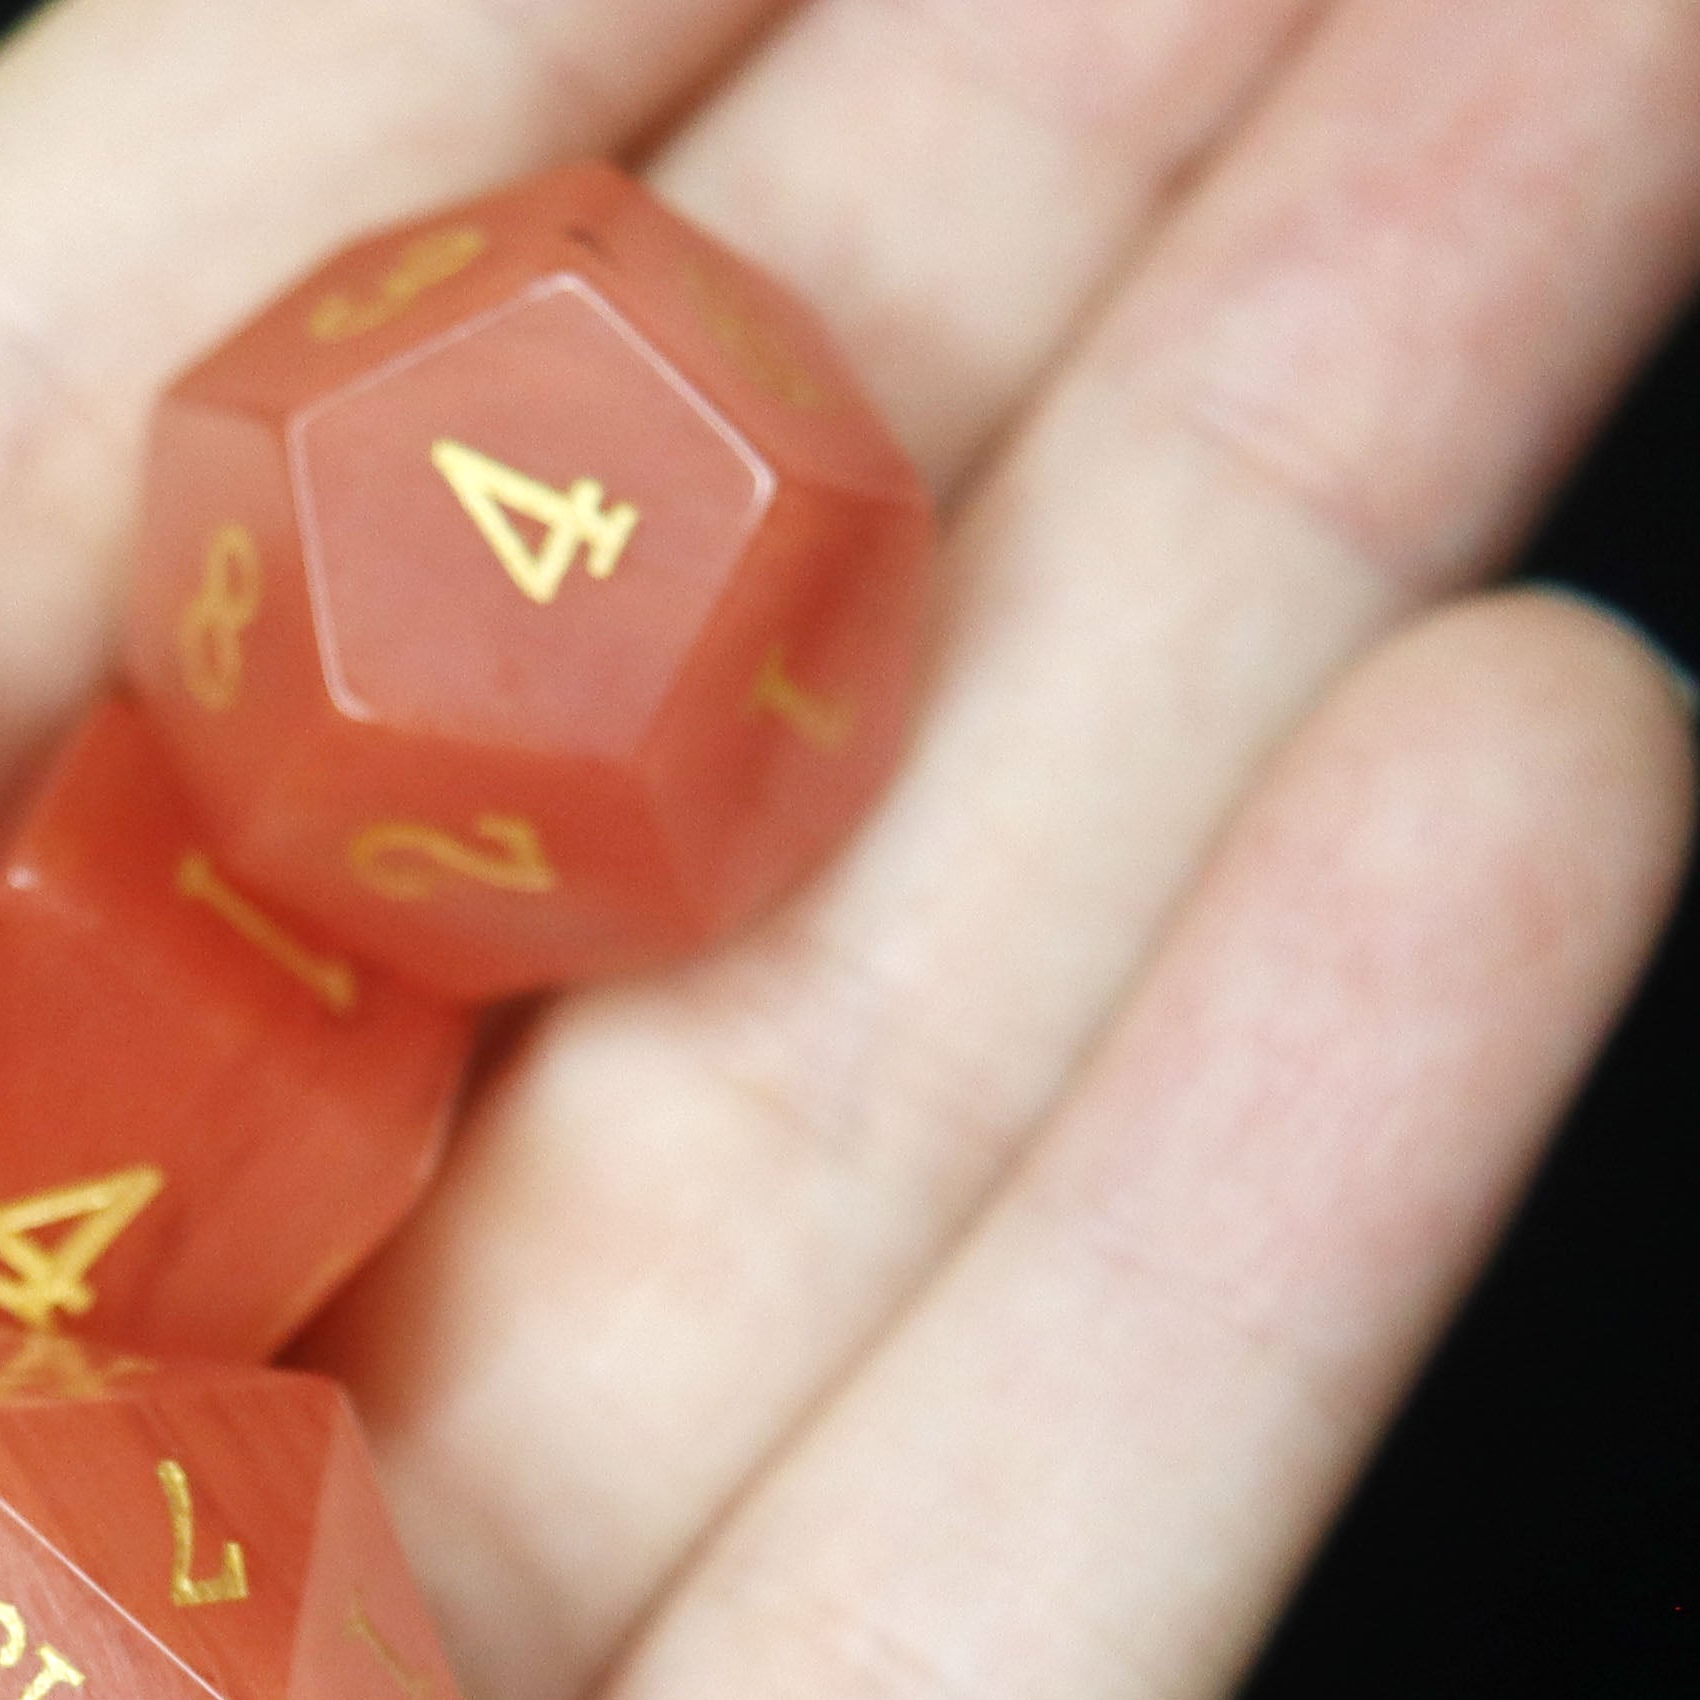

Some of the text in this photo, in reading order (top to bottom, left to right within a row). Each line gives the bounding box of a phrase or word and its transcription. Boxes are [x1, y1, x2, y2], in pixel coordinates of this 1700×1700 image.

[430, 438, 641, 605] 4
[170, 525, 262, 712] 8
[350, 815, 558, 900] 2
[157, 1460, 249, 1606] 7
